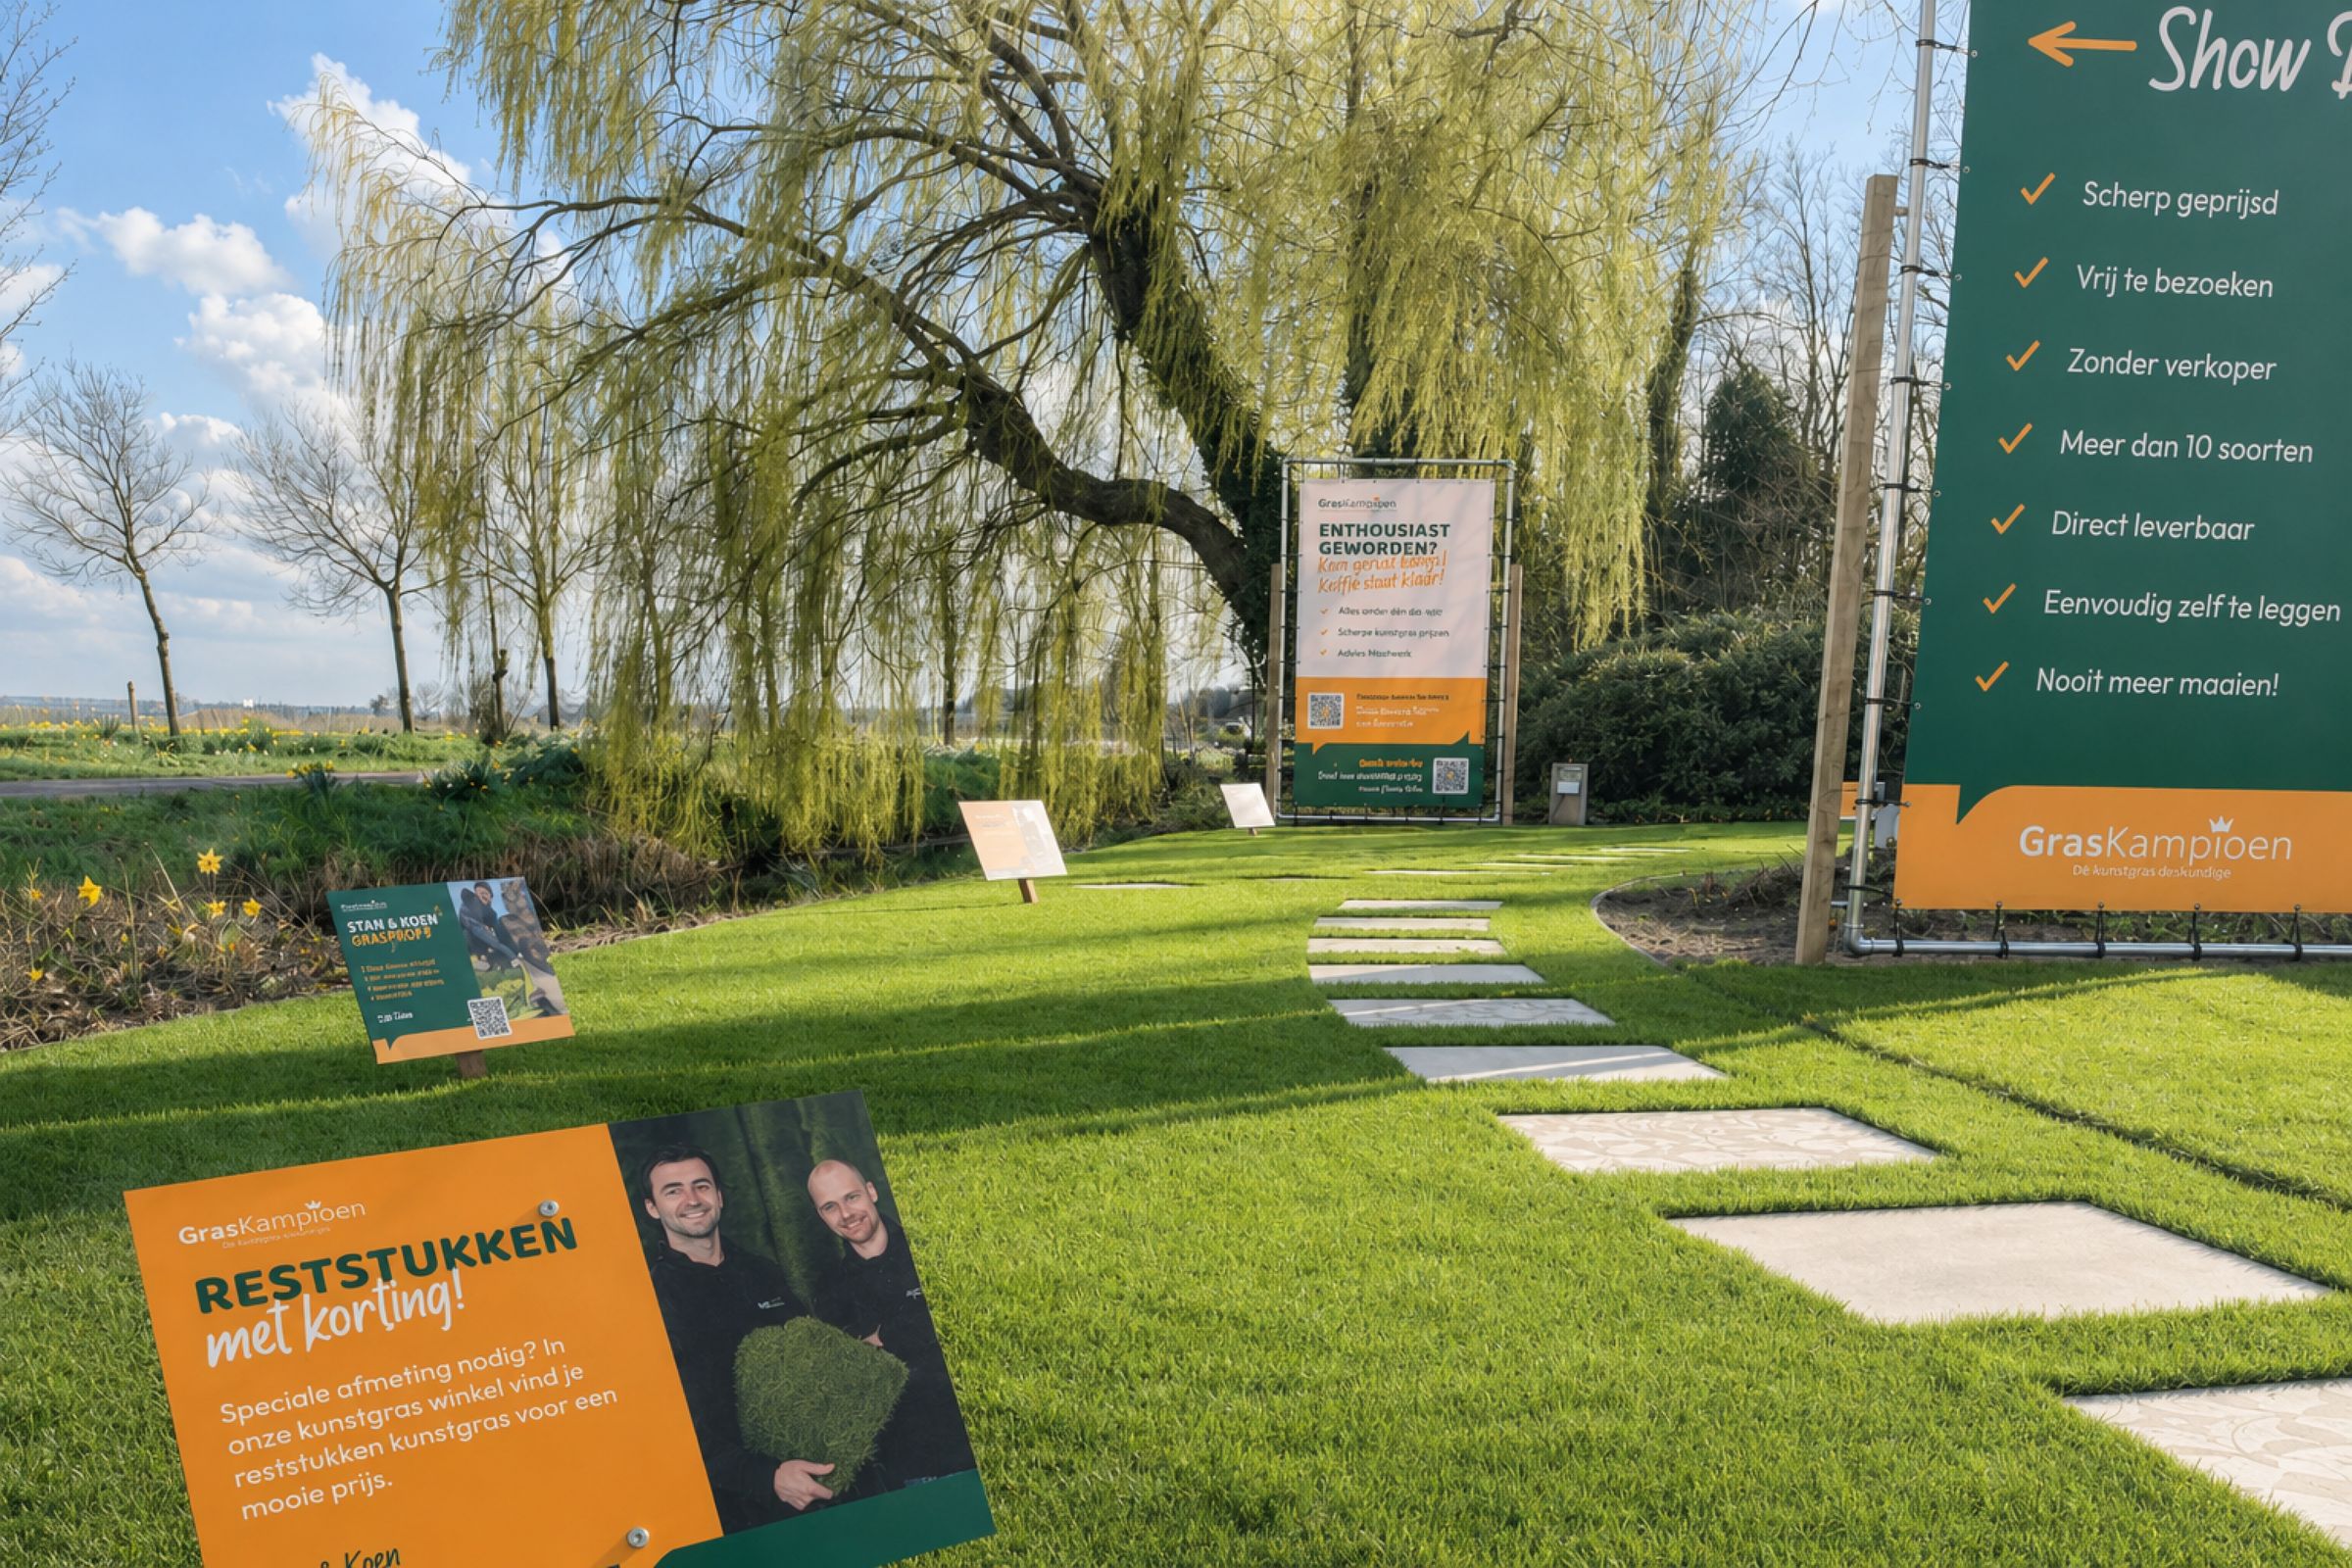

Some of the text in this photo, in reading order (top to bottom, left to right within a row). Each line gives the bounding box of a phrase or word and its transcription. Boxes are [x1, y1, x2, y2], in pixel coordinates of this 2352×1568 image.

[2148, 6, 2312, 92] Show
[2082, 181, 2279, 220] Scherp geprijsd
[2078, 265, 2274, 298] Vrij te bezoeken
[2068, 349, 2278, 386] Zonder verkoper
[2060, 429, 2314, 464] Meer dan 10 soorten
[1319, 523, 1450, 538] ENTHOUSIAST
[2052, 511, 2255, 541] Direct leverbaar
[1319, 541, 1438, 556] GEWORDEN?
[2044, 590, 2342, 627] Eenvoudig zelf te leggen
[2036, 667, 2279, 697] Nooit meer maaien!
[2019, 825, 2292, 866] GrasKampioen
[2093, 865, 2156, 879] kunstgras
[347, 917, 385, 933] STAN
[399, 912, 439, 928] KOEN
[178, 1200, 368, 1245] GrasKampioen
[195, 1217, 578, 1314] RESTSTUKKEN
[207, 1268, 466, 1369] met korting!
[220, 1338, 565, 1426] Speciale afmeting nodig? In
[228, 1364, 584, 1454] onze kunstgras winkel vind je
[233, 1389, 618, 1488] reststukken kunstgras voor een
[241, 1472, 393, 1521] mooie prijs.
